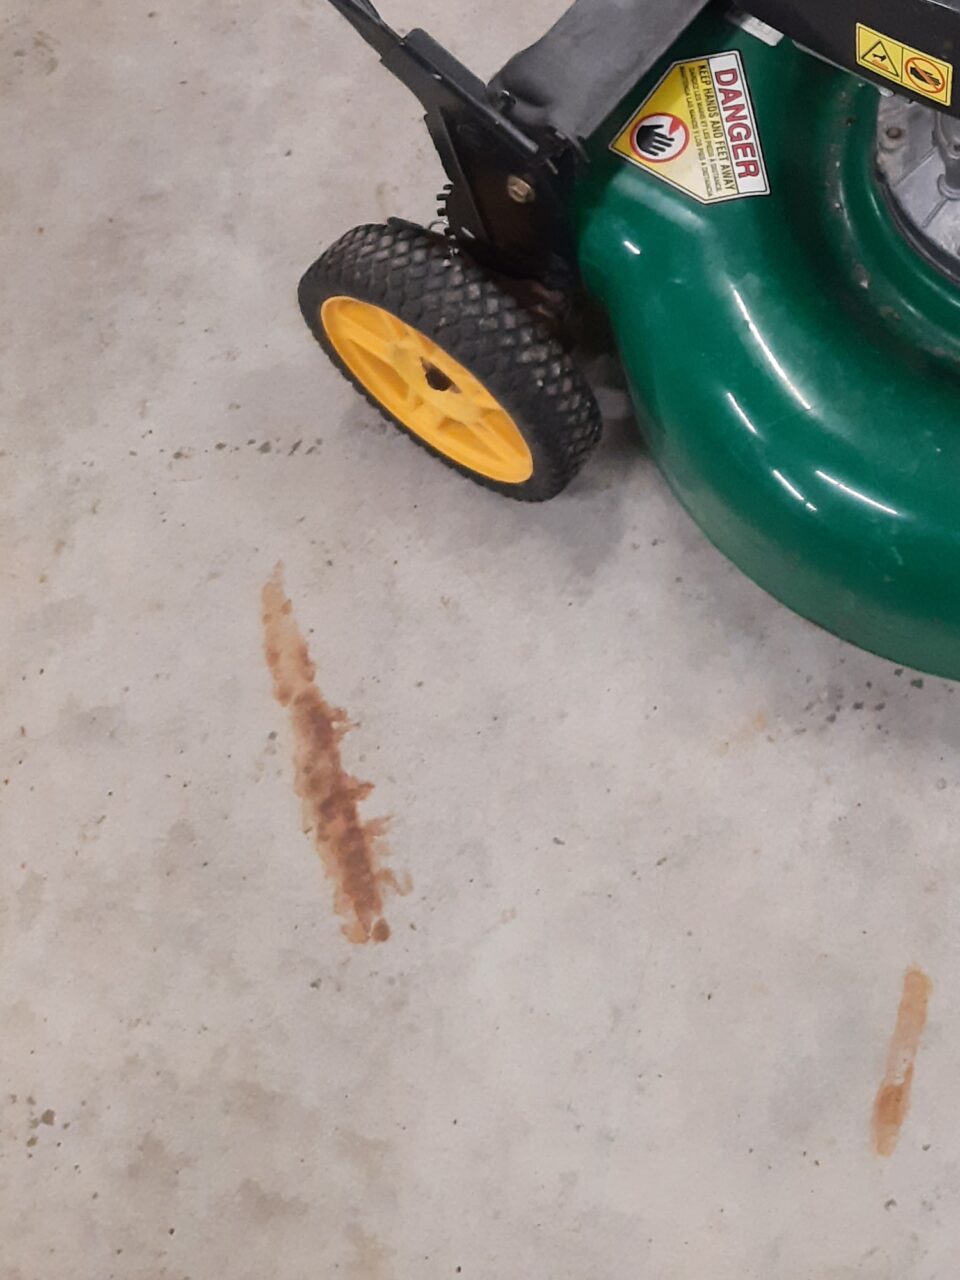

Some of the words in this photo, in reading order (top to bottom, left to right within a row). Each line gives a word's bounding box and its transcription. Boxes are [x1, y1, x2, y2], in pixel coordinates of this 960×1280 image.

[698, 65, 711, 86] KEEP
[703, 88, 718, 118] HANDS
[711, 120, 723, 139] AND
[715, 68, 760, 179] DANGER
[716, 141, 729, 163] FEET
[721, 164, 735, 192] AWAY
